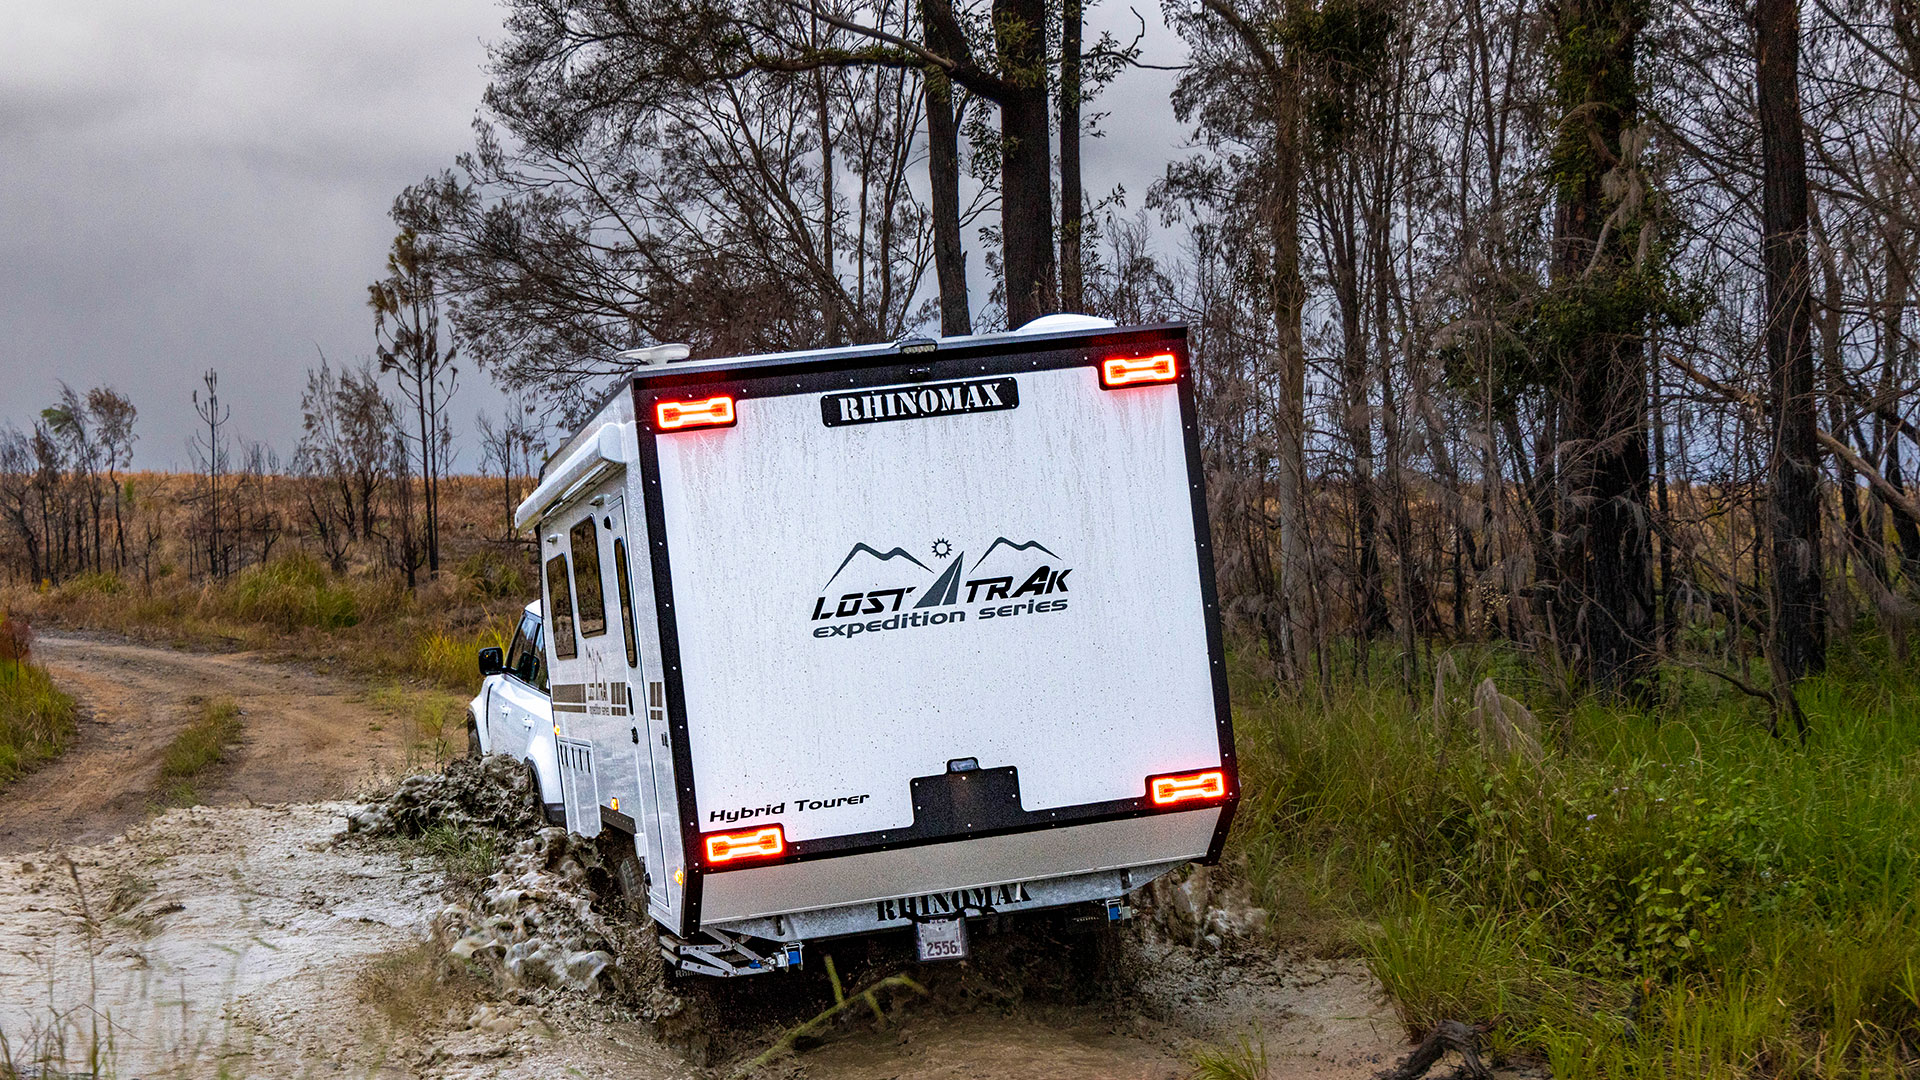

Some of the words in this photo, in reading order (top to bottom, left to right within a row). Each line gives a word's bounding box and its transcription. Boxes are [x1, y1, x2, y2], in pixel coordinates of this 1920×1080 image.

[838, 383, 1003, 421] RHINOMAX
[811, 586, 917, 621] LOST
[965, 565, 1073, 604] TRAK
[812, 610, 966, 639] expedition
[978, 598, 1068, 620] series
[709, 802, 785, 823] Hybrid
[794, 794, 870, 812] Tourer
[927, 940, 957, 956] 2556
